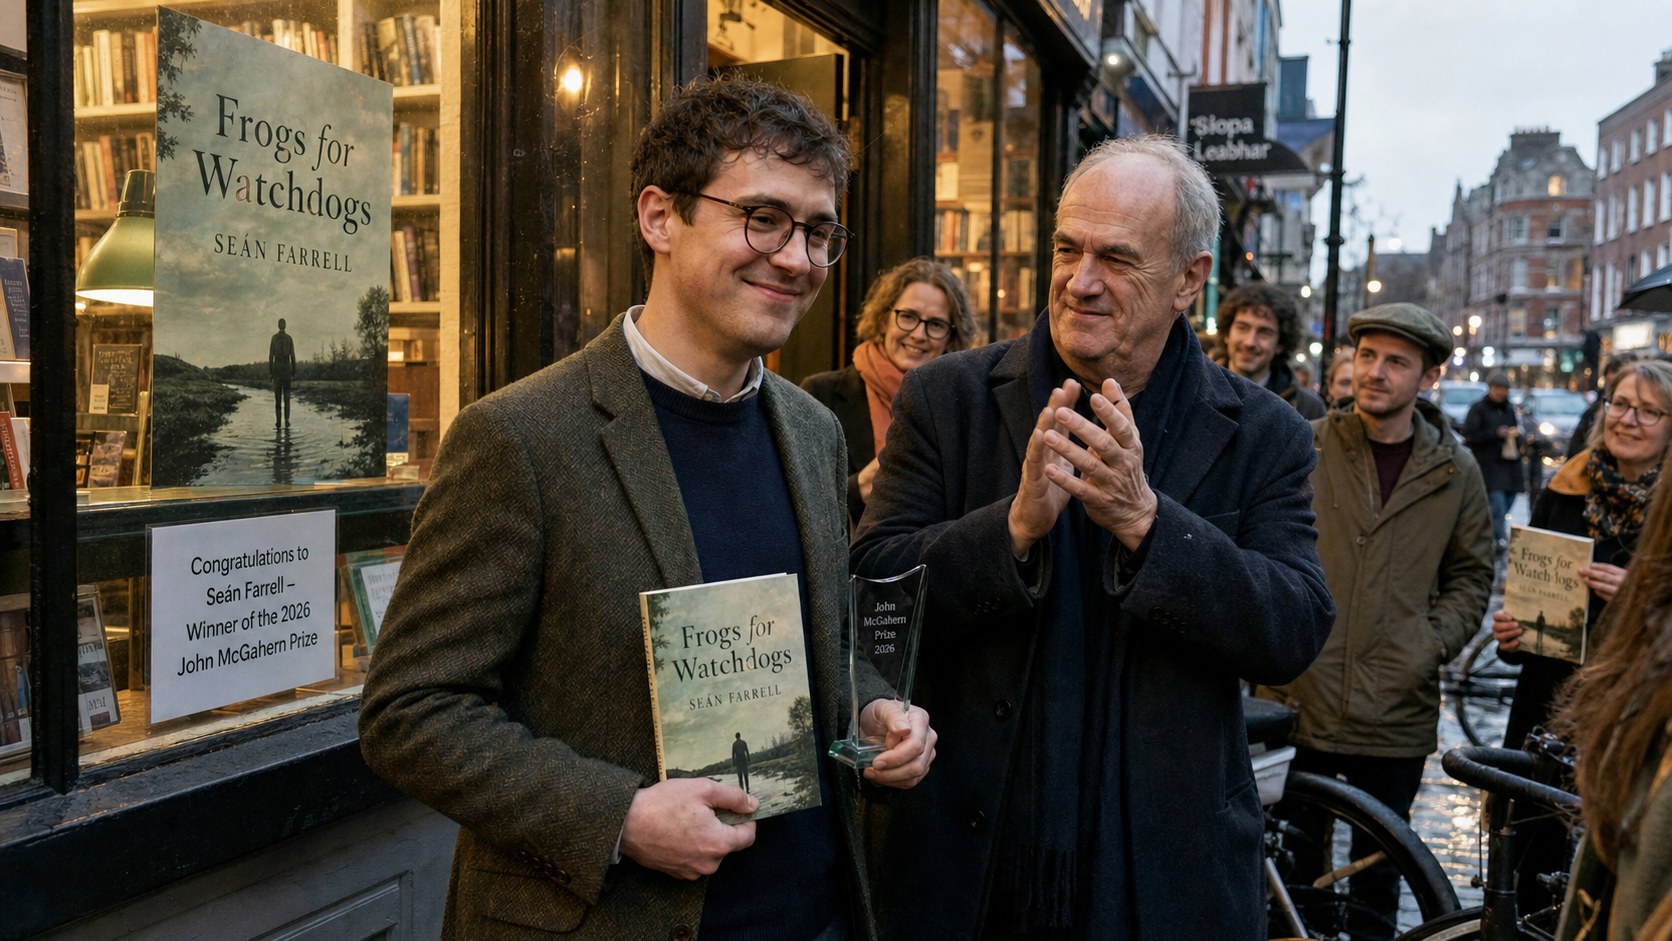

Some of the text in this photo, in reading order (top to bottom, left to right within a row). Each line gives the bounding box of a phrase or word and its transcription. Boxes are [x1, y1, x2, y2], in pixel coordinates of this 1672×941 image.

[216, 93, 354, 171] Frogs for
[1194, 114, 1254, 138] Siopa
[1194, 137, 1272, 161] Leabhar
[192, 149, 371, 235] Watchdogs
[214, 233, 352, 272] SEÁN FARRELL
[191, 546, 309, 576] Congratulations to
[1522, 547, 1573, 571] Frogs for
[206, 585, 241, 606] Seán
[245, 576, 284, 599] Farrell
[186, 601, 311, 641] Winner of the 2026
[863, 615, 907, 627] McGahern
[874, 601, 896, 612] John
[681, 615, 774, 650] Frogs for
[874, 630, 896, 640] Prize
[177, 631, 318, 676] John McGahern Prize
[874, 643, 895, 654] 2026
[672, 647, 792, 683] Watchdogs
[690, 684, 782, 710] SEÁN FARRELL
